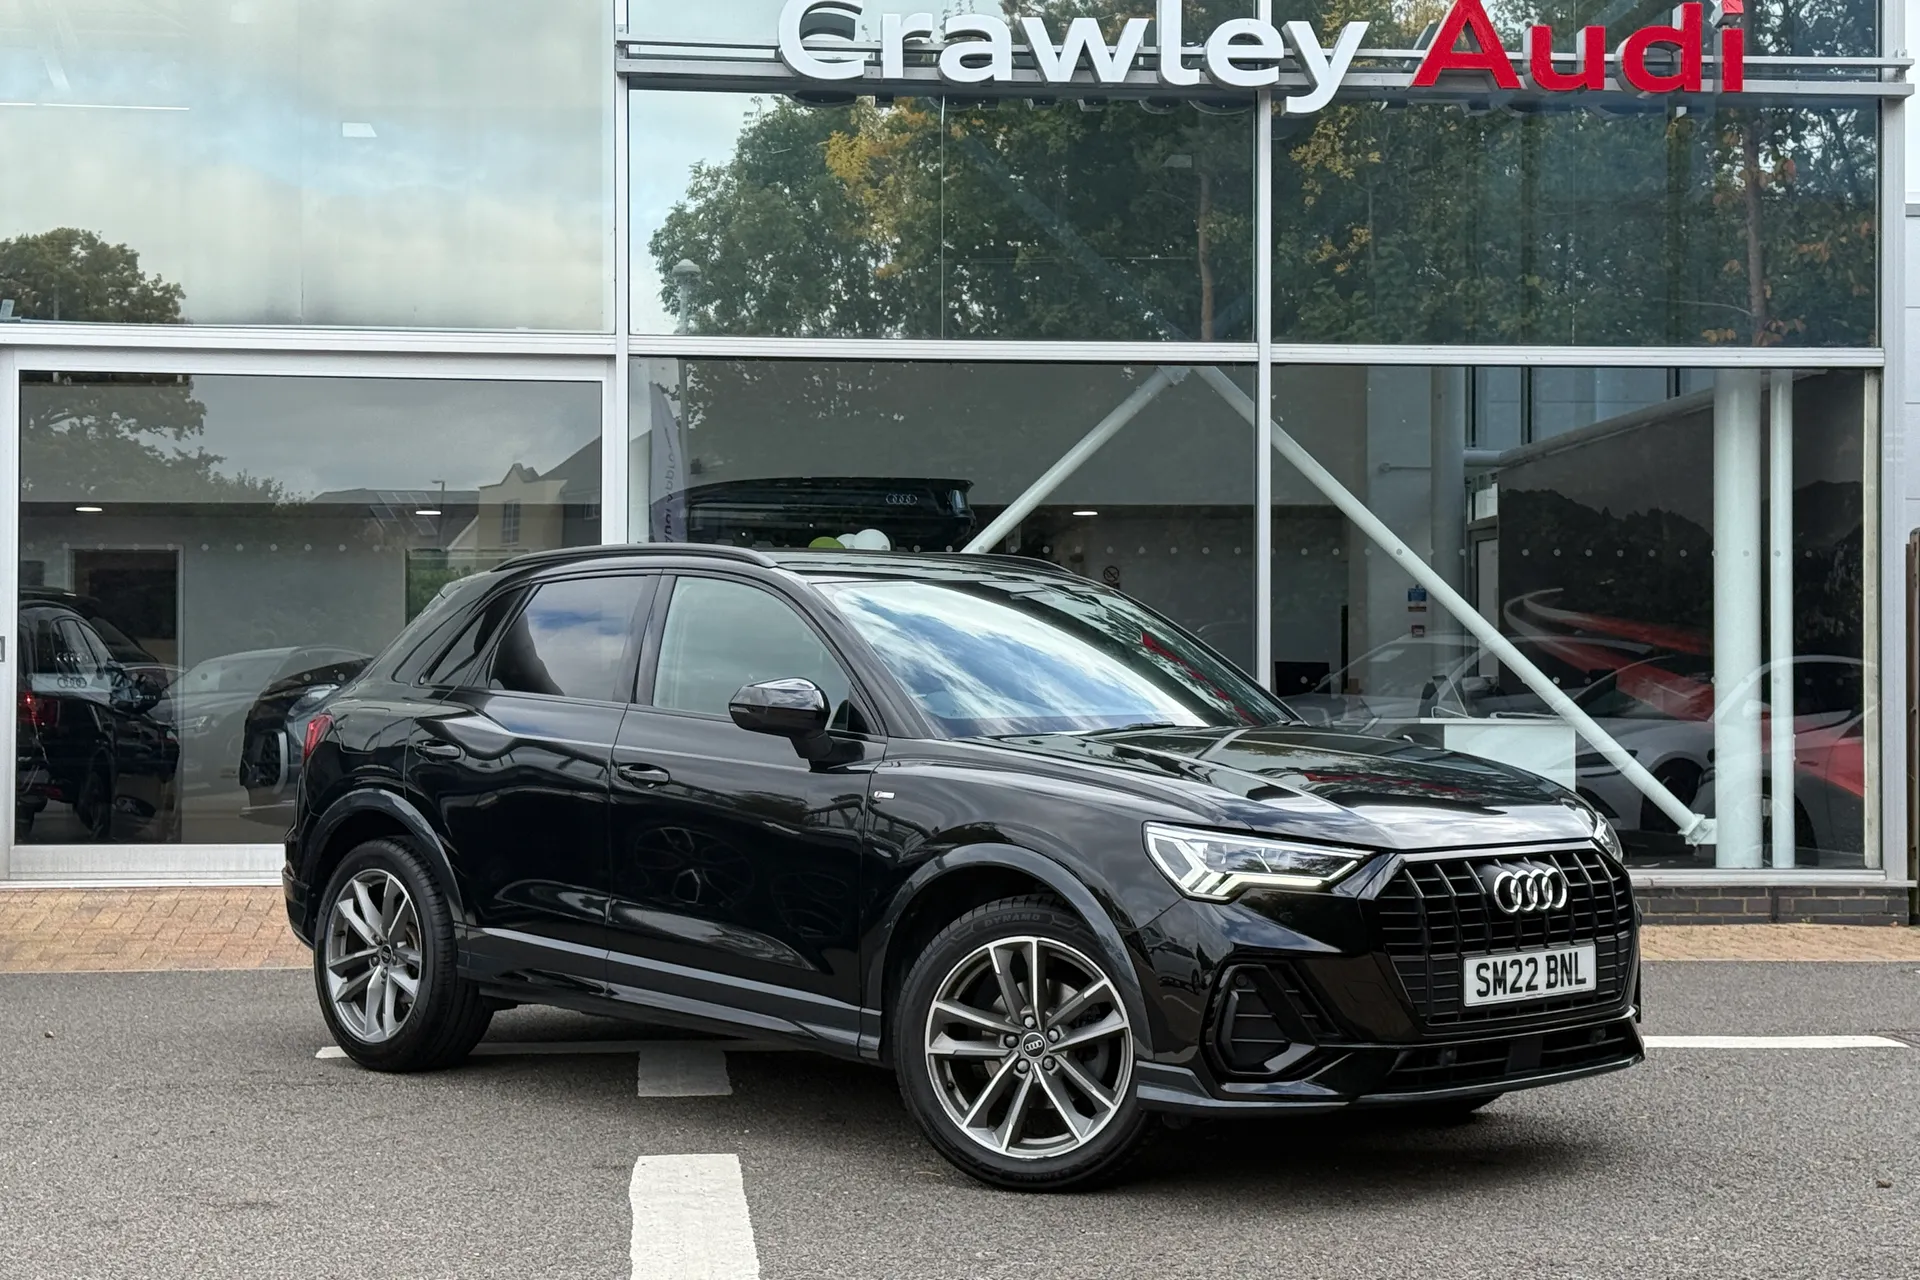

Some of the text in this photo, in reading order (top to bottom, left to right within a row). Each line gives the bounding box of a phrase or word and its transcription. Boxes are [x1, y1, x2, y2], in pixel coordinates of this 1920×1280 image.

[777, 0, 1744, 115] Crawley Audi
[984, 913, 1041, 927] DYNAMO
[1475, 951, 1587, 997] SM22 BNL
